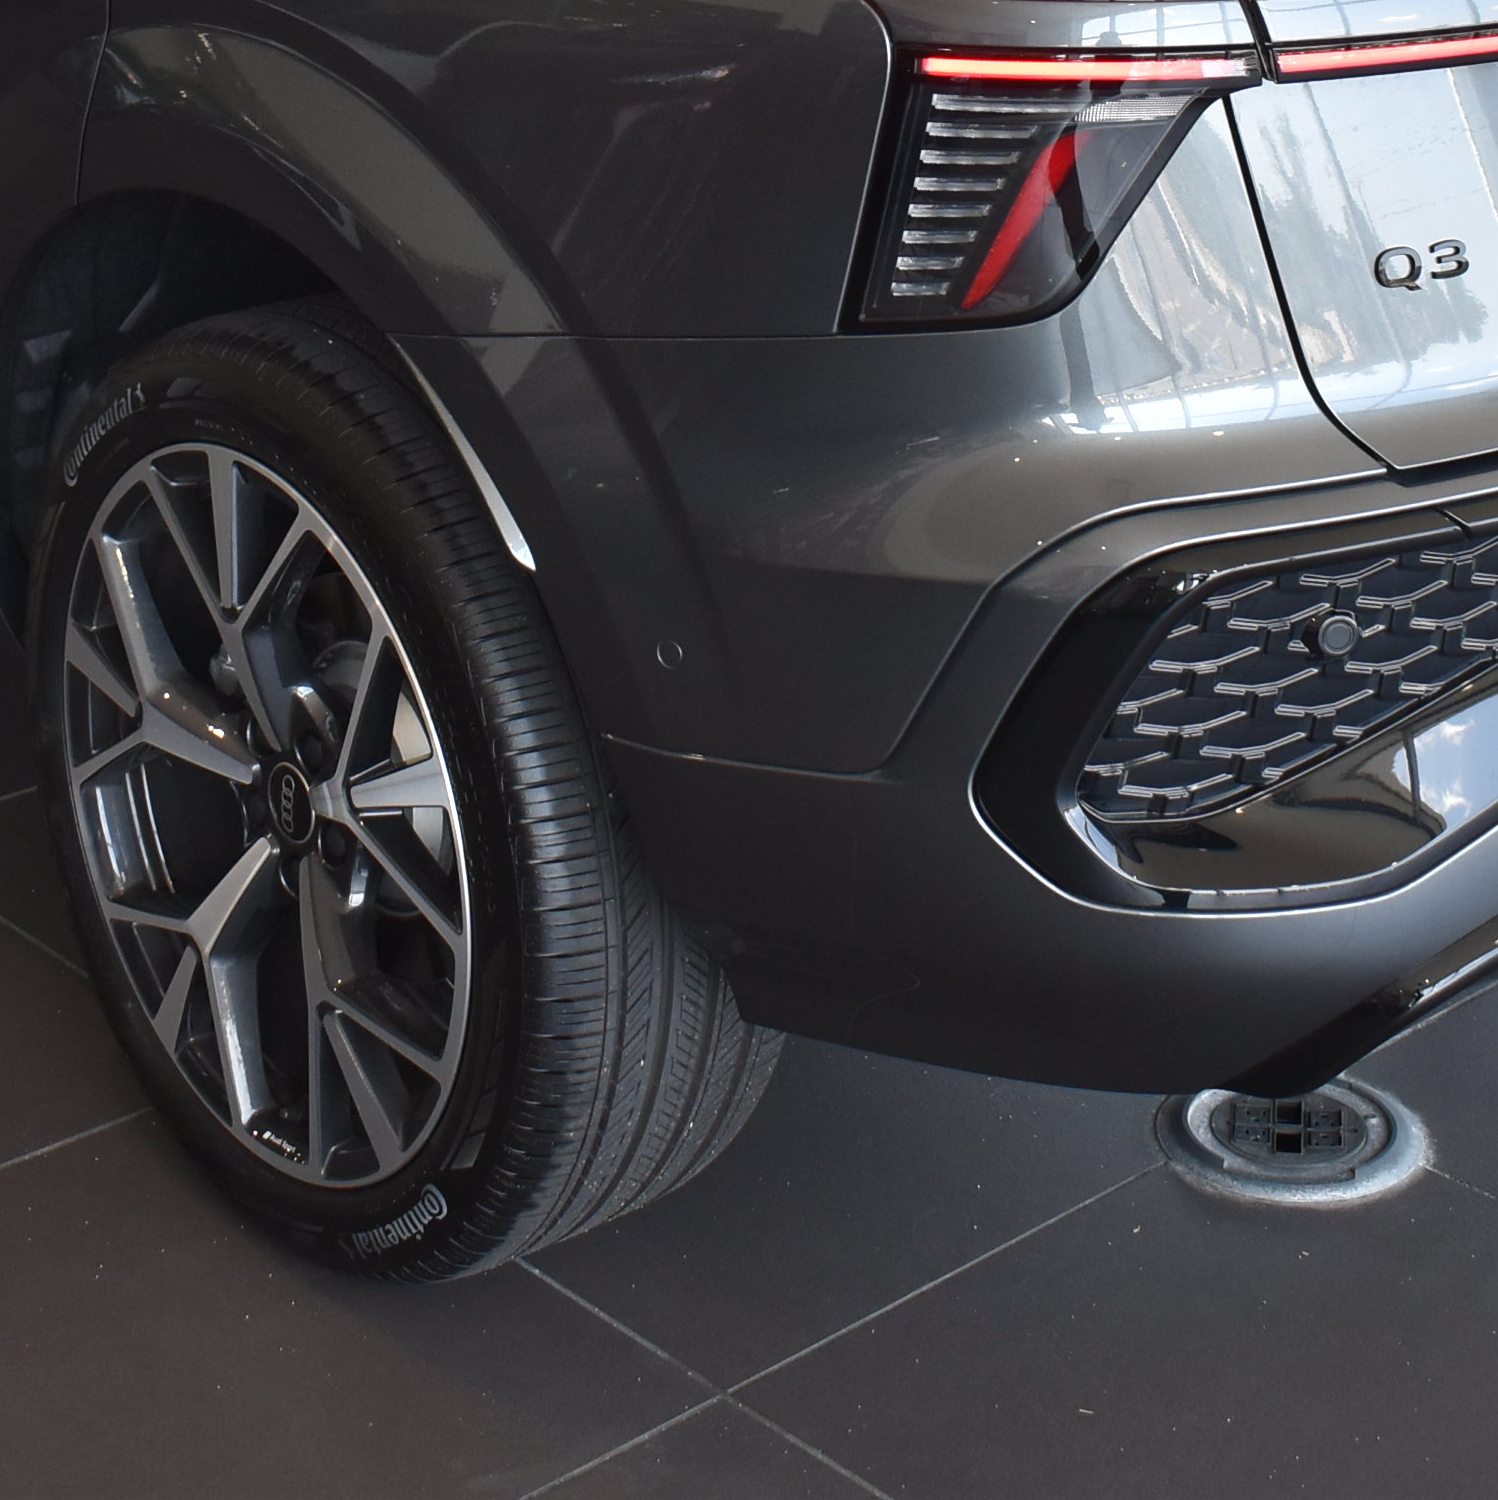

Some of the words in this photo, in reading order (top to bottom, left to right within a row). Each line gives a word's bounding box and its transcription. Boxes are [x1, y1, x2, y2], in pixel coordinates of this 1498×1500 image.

[1374, 239, 1470, 291] Q3
[64, 387, 134, 487] Continental
[352, 1183, 448, 1260] Continental
